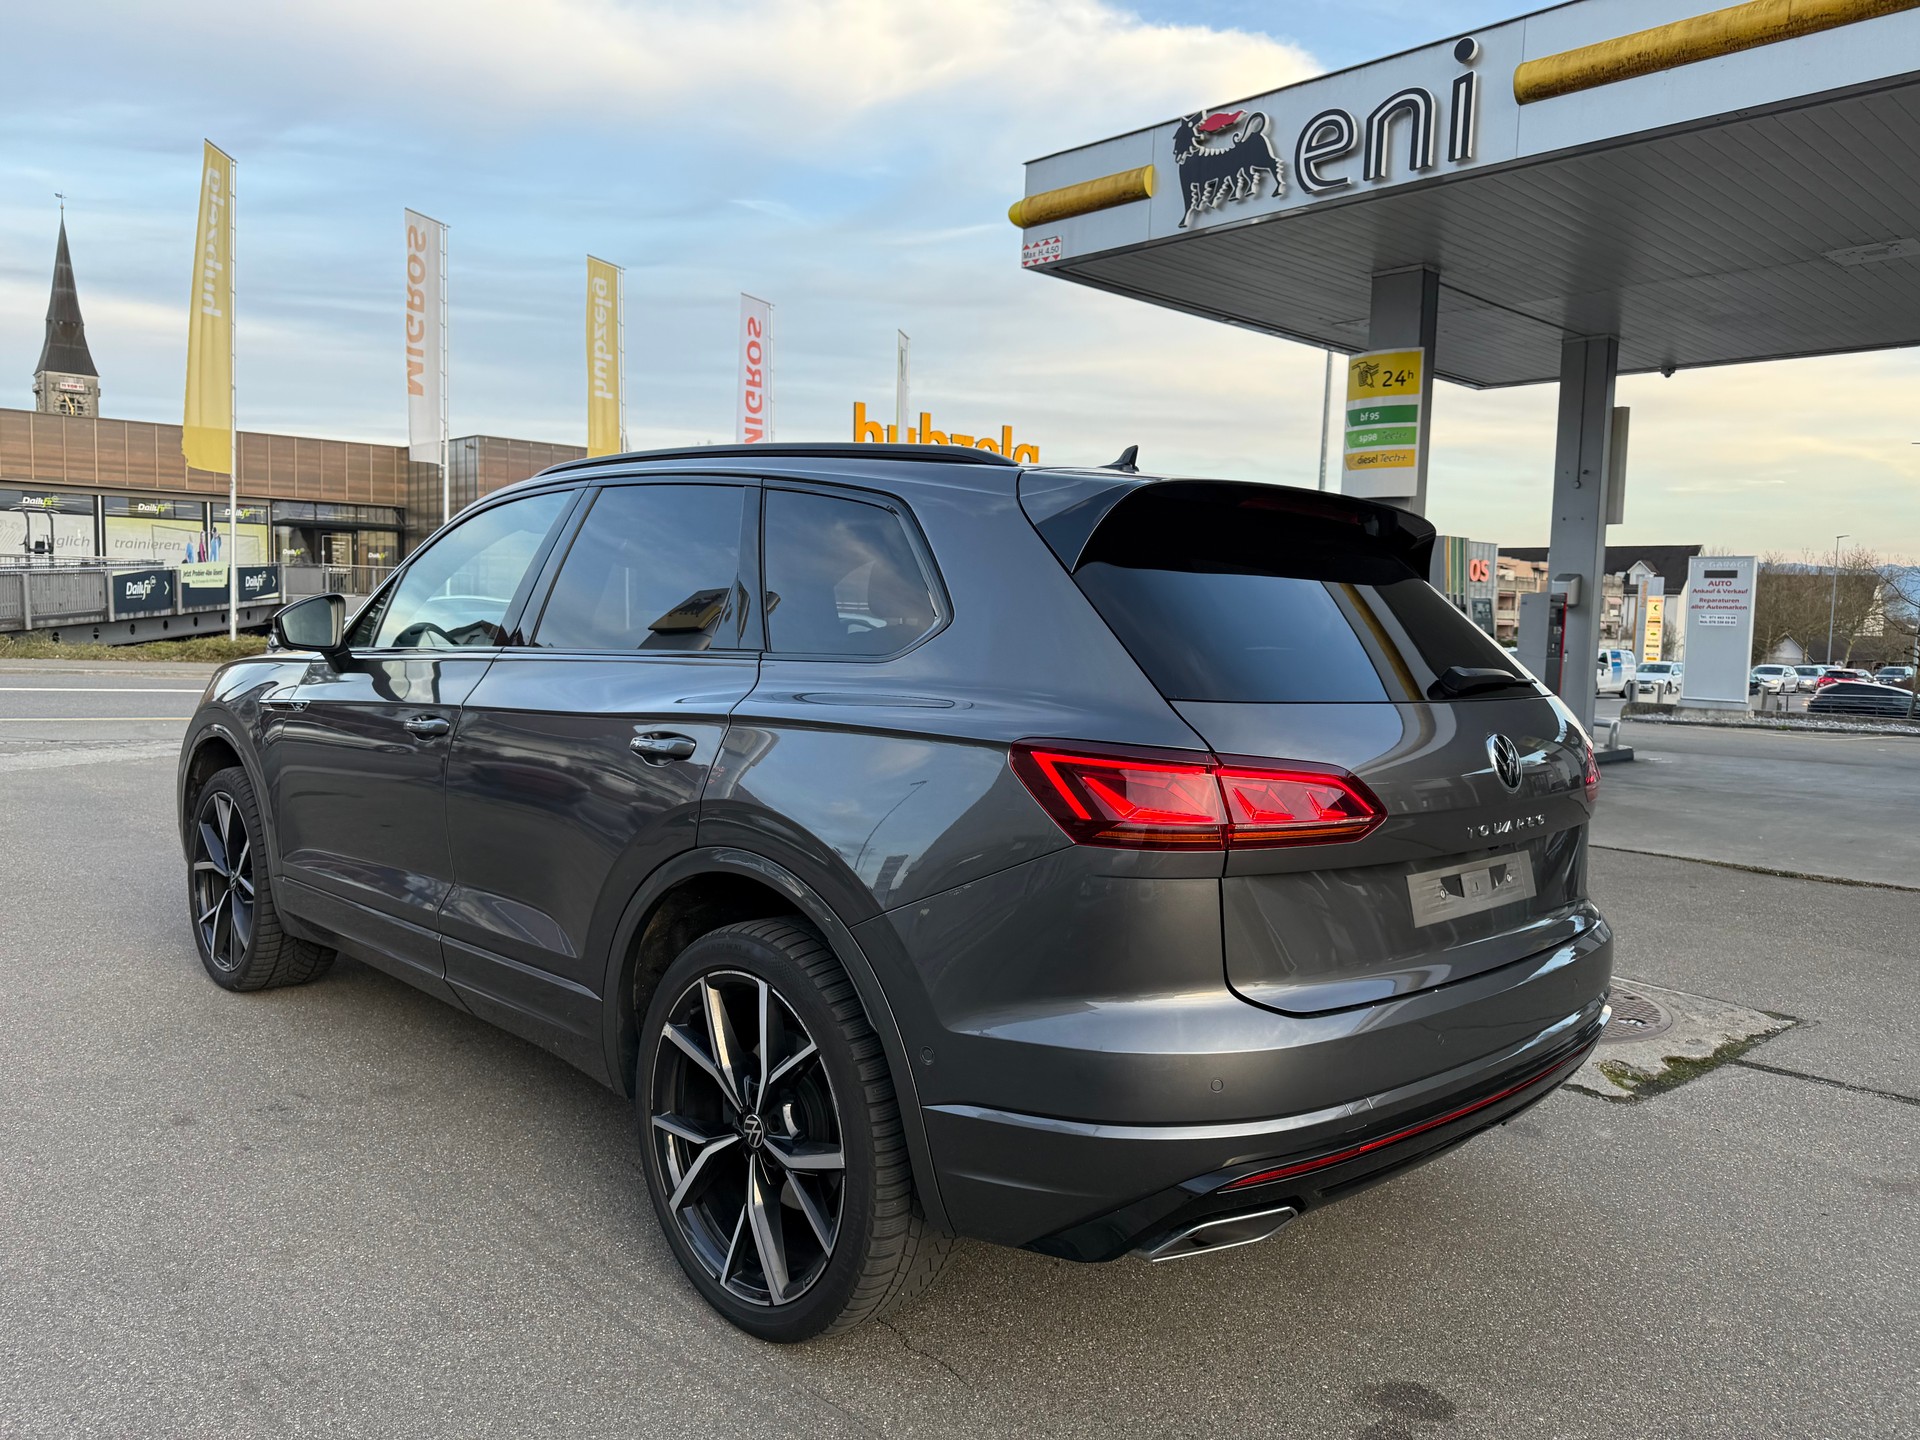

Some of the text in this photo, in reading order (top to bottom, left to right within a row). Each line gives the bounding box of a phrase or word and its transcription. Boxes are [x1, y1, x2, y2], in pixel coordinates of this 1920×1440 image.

[1295, 37, 1479, 195] eni
[1360, 412, 1380, 421] bf 95
[1357, 453, 1378, 465] diesel
